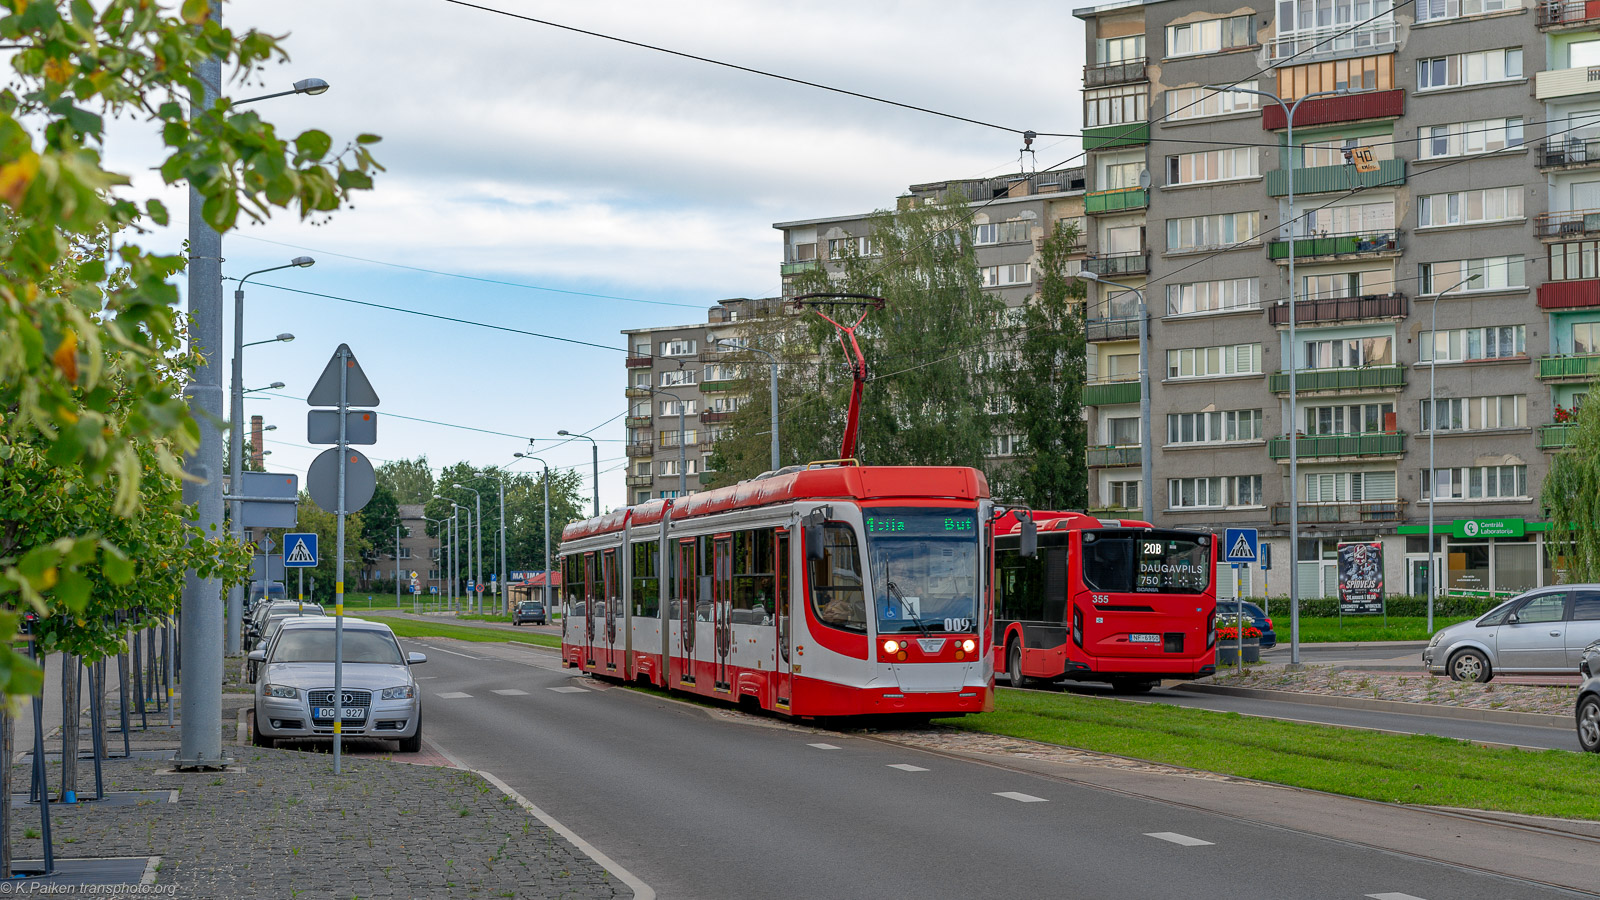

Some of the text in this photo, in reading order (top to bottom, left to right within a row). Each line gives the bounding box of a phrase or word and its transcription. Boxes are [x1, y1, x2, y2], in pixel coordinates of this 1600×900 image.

[1356, 150, 1372, 162] 40
[944, 517, 971, 531] But
[1144, 543, 1162, 554] 20B
[1140, 563, 1203, 574] DAUGAVPILS
[1140, 576, 1159, 585] 750
[1092, 594, 1109, 604] 355
[944, 618, 970, 632] 009
[346, 709, 363, 717] 927
